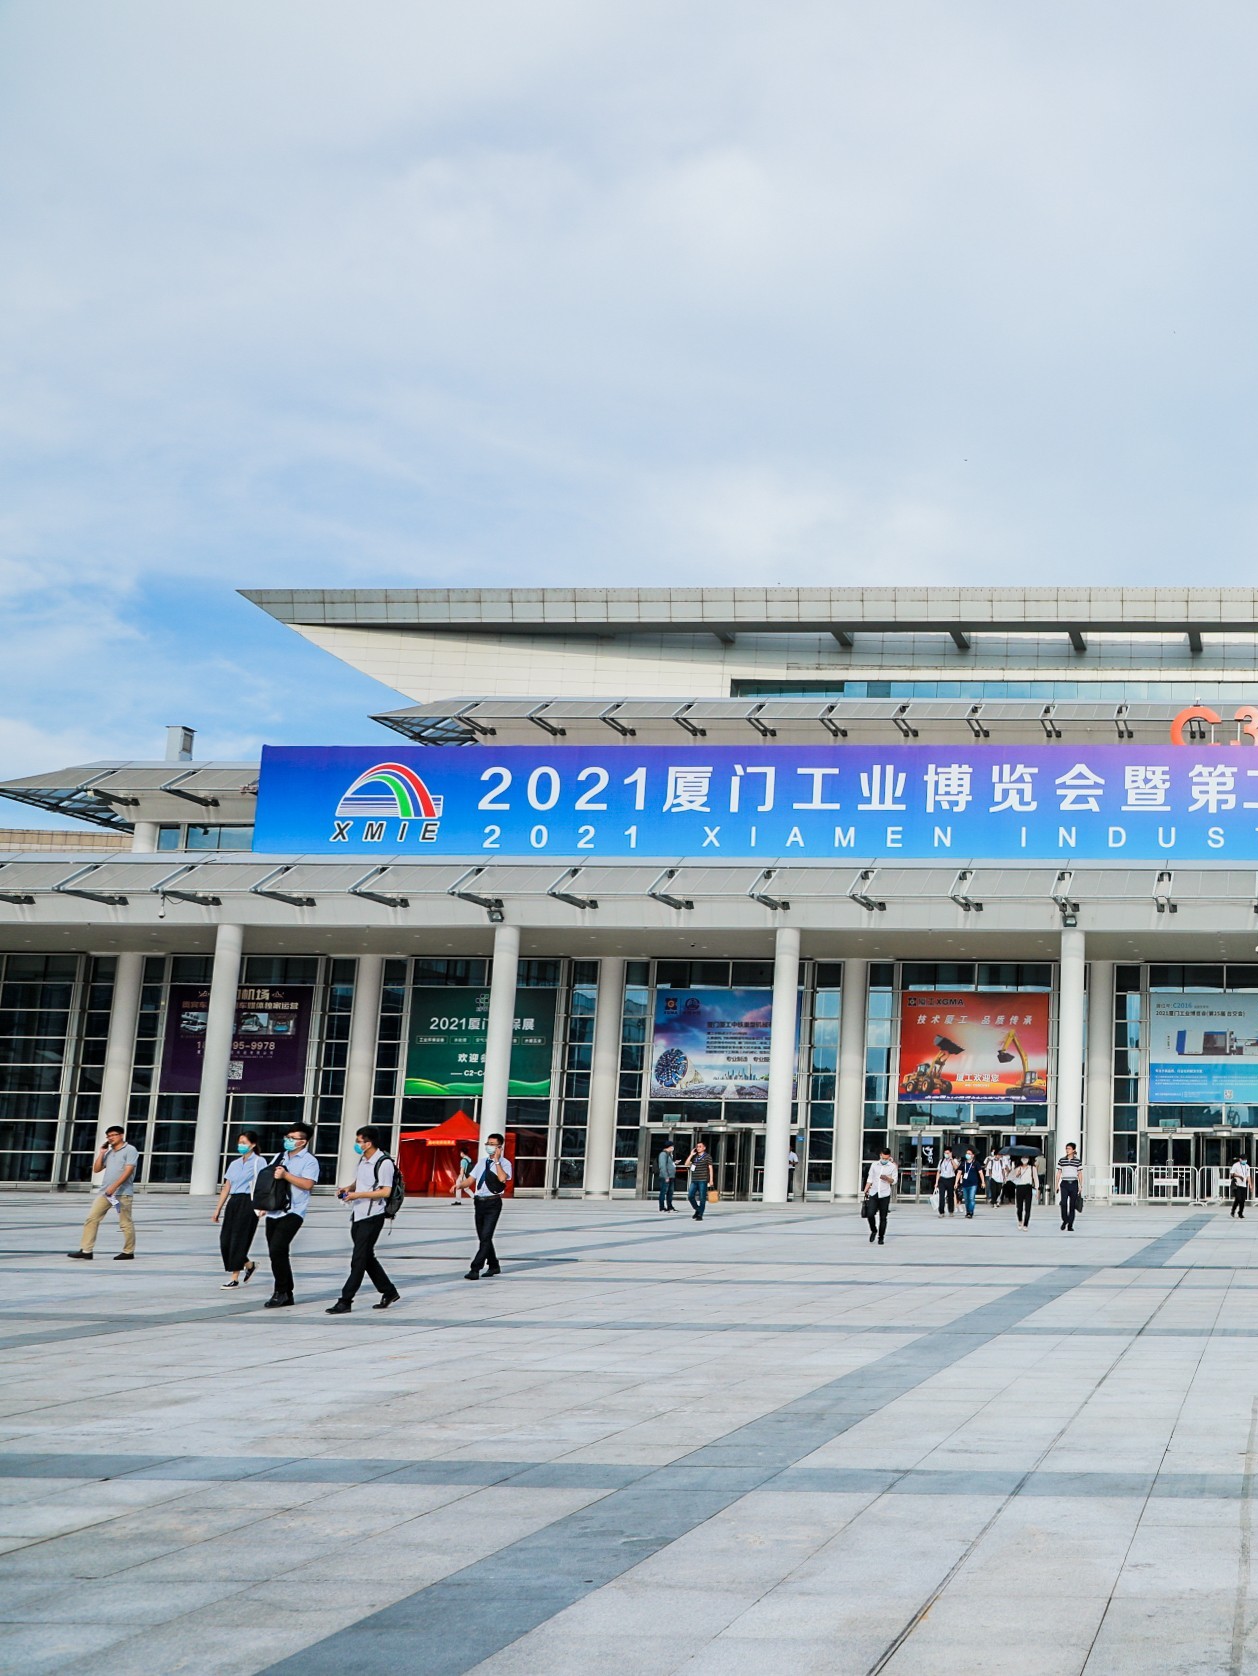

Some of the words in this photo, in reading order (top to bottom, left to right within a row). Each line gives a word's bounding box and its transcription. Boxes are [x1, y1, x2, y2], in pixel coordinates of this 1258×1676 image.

[330, 821, 440, 842] XMIE
[482, 826, 640, 849] 2021
[702, 826, 952, 850] XIAMEN
[916, 1014, 968, 1025] 技术厦工
[981, 1015, 1032, 1025] 品质传承
